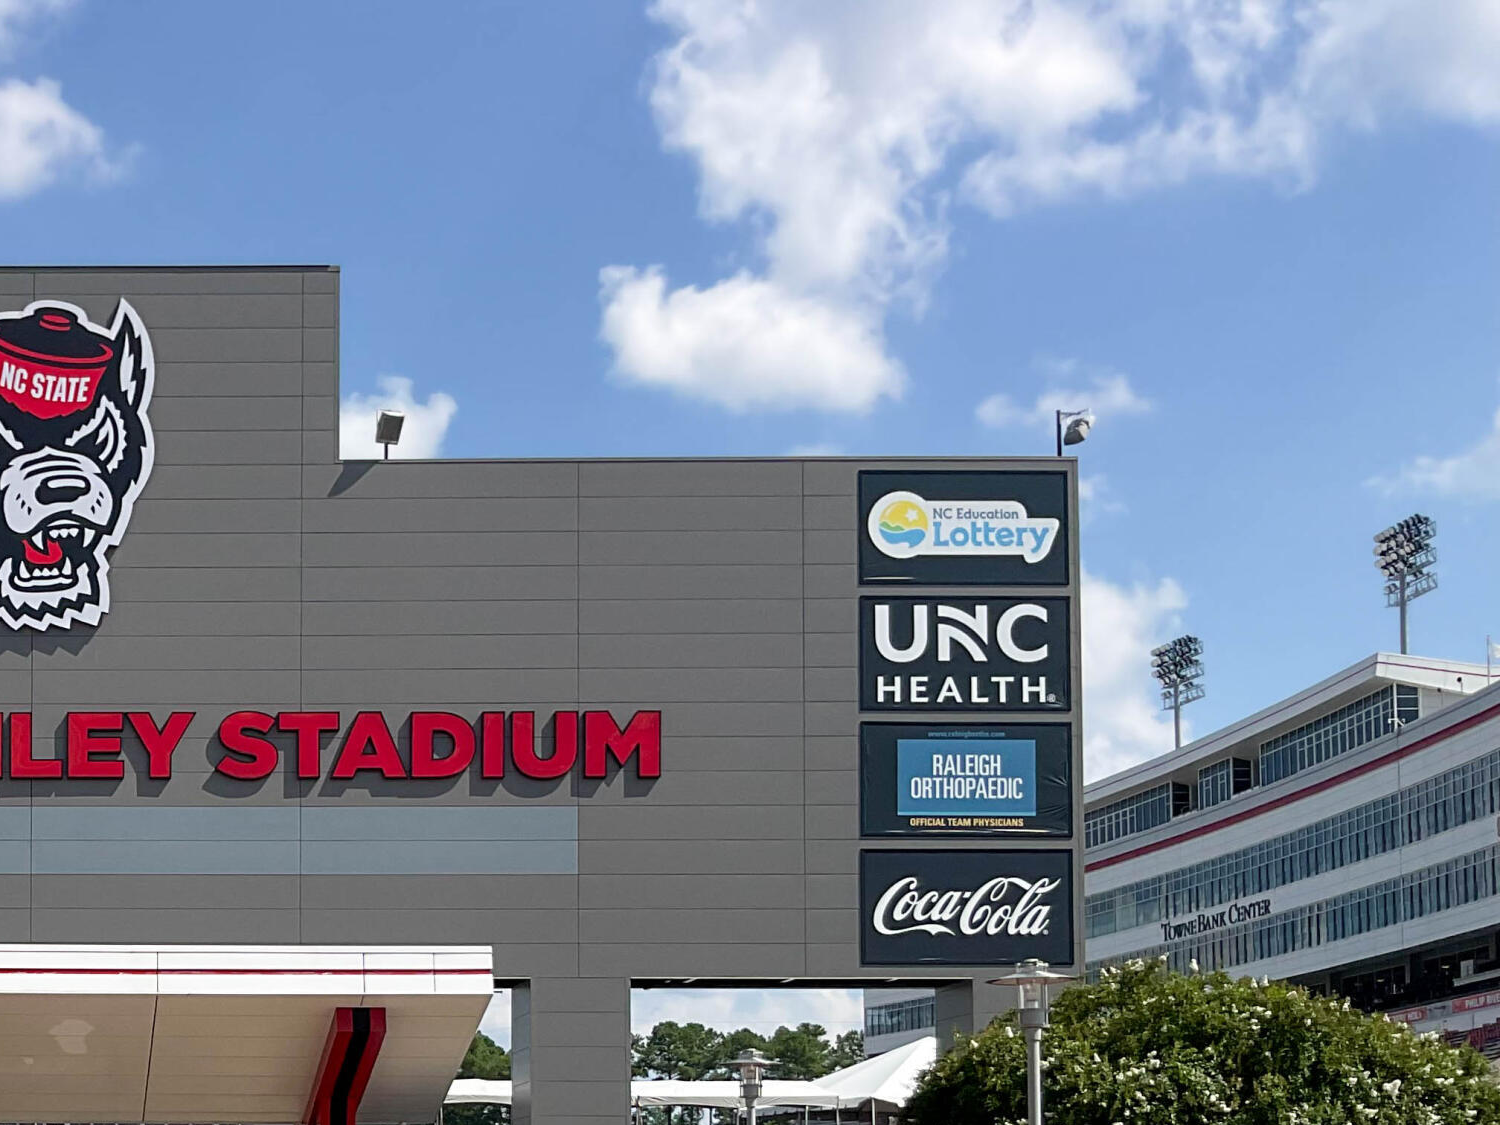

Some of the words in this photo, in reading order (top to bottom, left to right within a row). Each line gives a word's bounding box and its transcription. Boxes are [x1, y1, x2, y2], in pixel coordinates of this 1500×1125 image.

[0, 361, 28, 394] NC
[30, 373, 90, 403] STATE
[932, 508, 953, 520] NC
[956, 507, 1019, 520] Education
[932, 521, 1050, 553] Lottery
[874, 603, 1048, 663] UNC
[877, 676, 1047, 703] HEALTH
[216, 710, 663, 781] STADIUM
[932, 754, 1001, 776] RALEIGH
[910, 777, 1024, 800] ORTHOPAEDIC
[909, 817, 946, 827] OFFICIAL
[947, 818, 971, 827] TEAM
[973, 818, 1024, 827] PHYSICIANS
[873, 876, 1062, 937] Coca-Cola
[1228, 899, 1271, 924] CENTER
